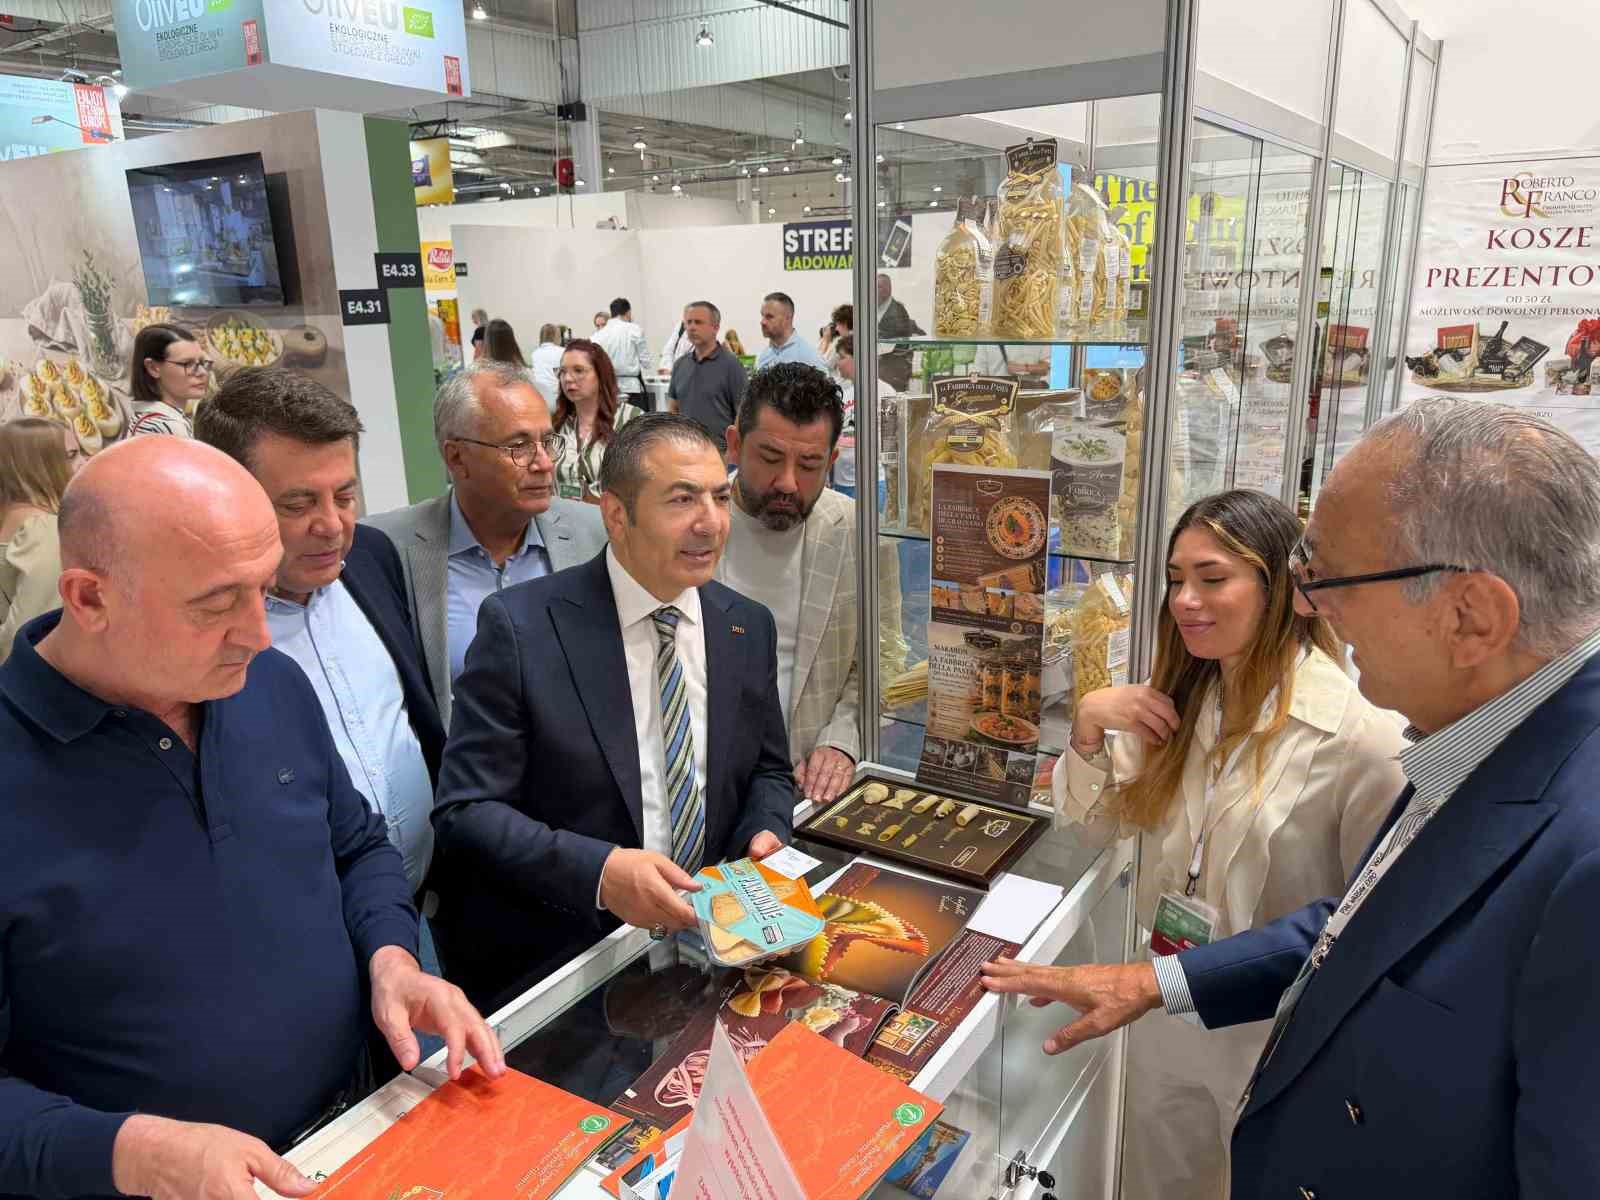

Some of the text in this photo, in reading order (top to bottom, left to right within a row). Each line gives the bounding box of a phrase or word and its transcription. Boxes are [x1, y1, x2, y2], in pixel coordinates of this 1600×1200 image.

[156, 24, 199, 41] EKOLOGICZNE
[329, 22, 388, 42] EKOLOGICZNE
[1487, 226, 1593, 250] KOSZE
[382, 263, 416, 277] E4.33
[1425, 264, 1600, 288] PREZENTO
[347, 300, 381, 314] E4.31
[1505, 295, 1522, 304] OD
[1526, 295, 1538, 304] 50
[1487, 305, 1547, 317] DOWOLNEJ
